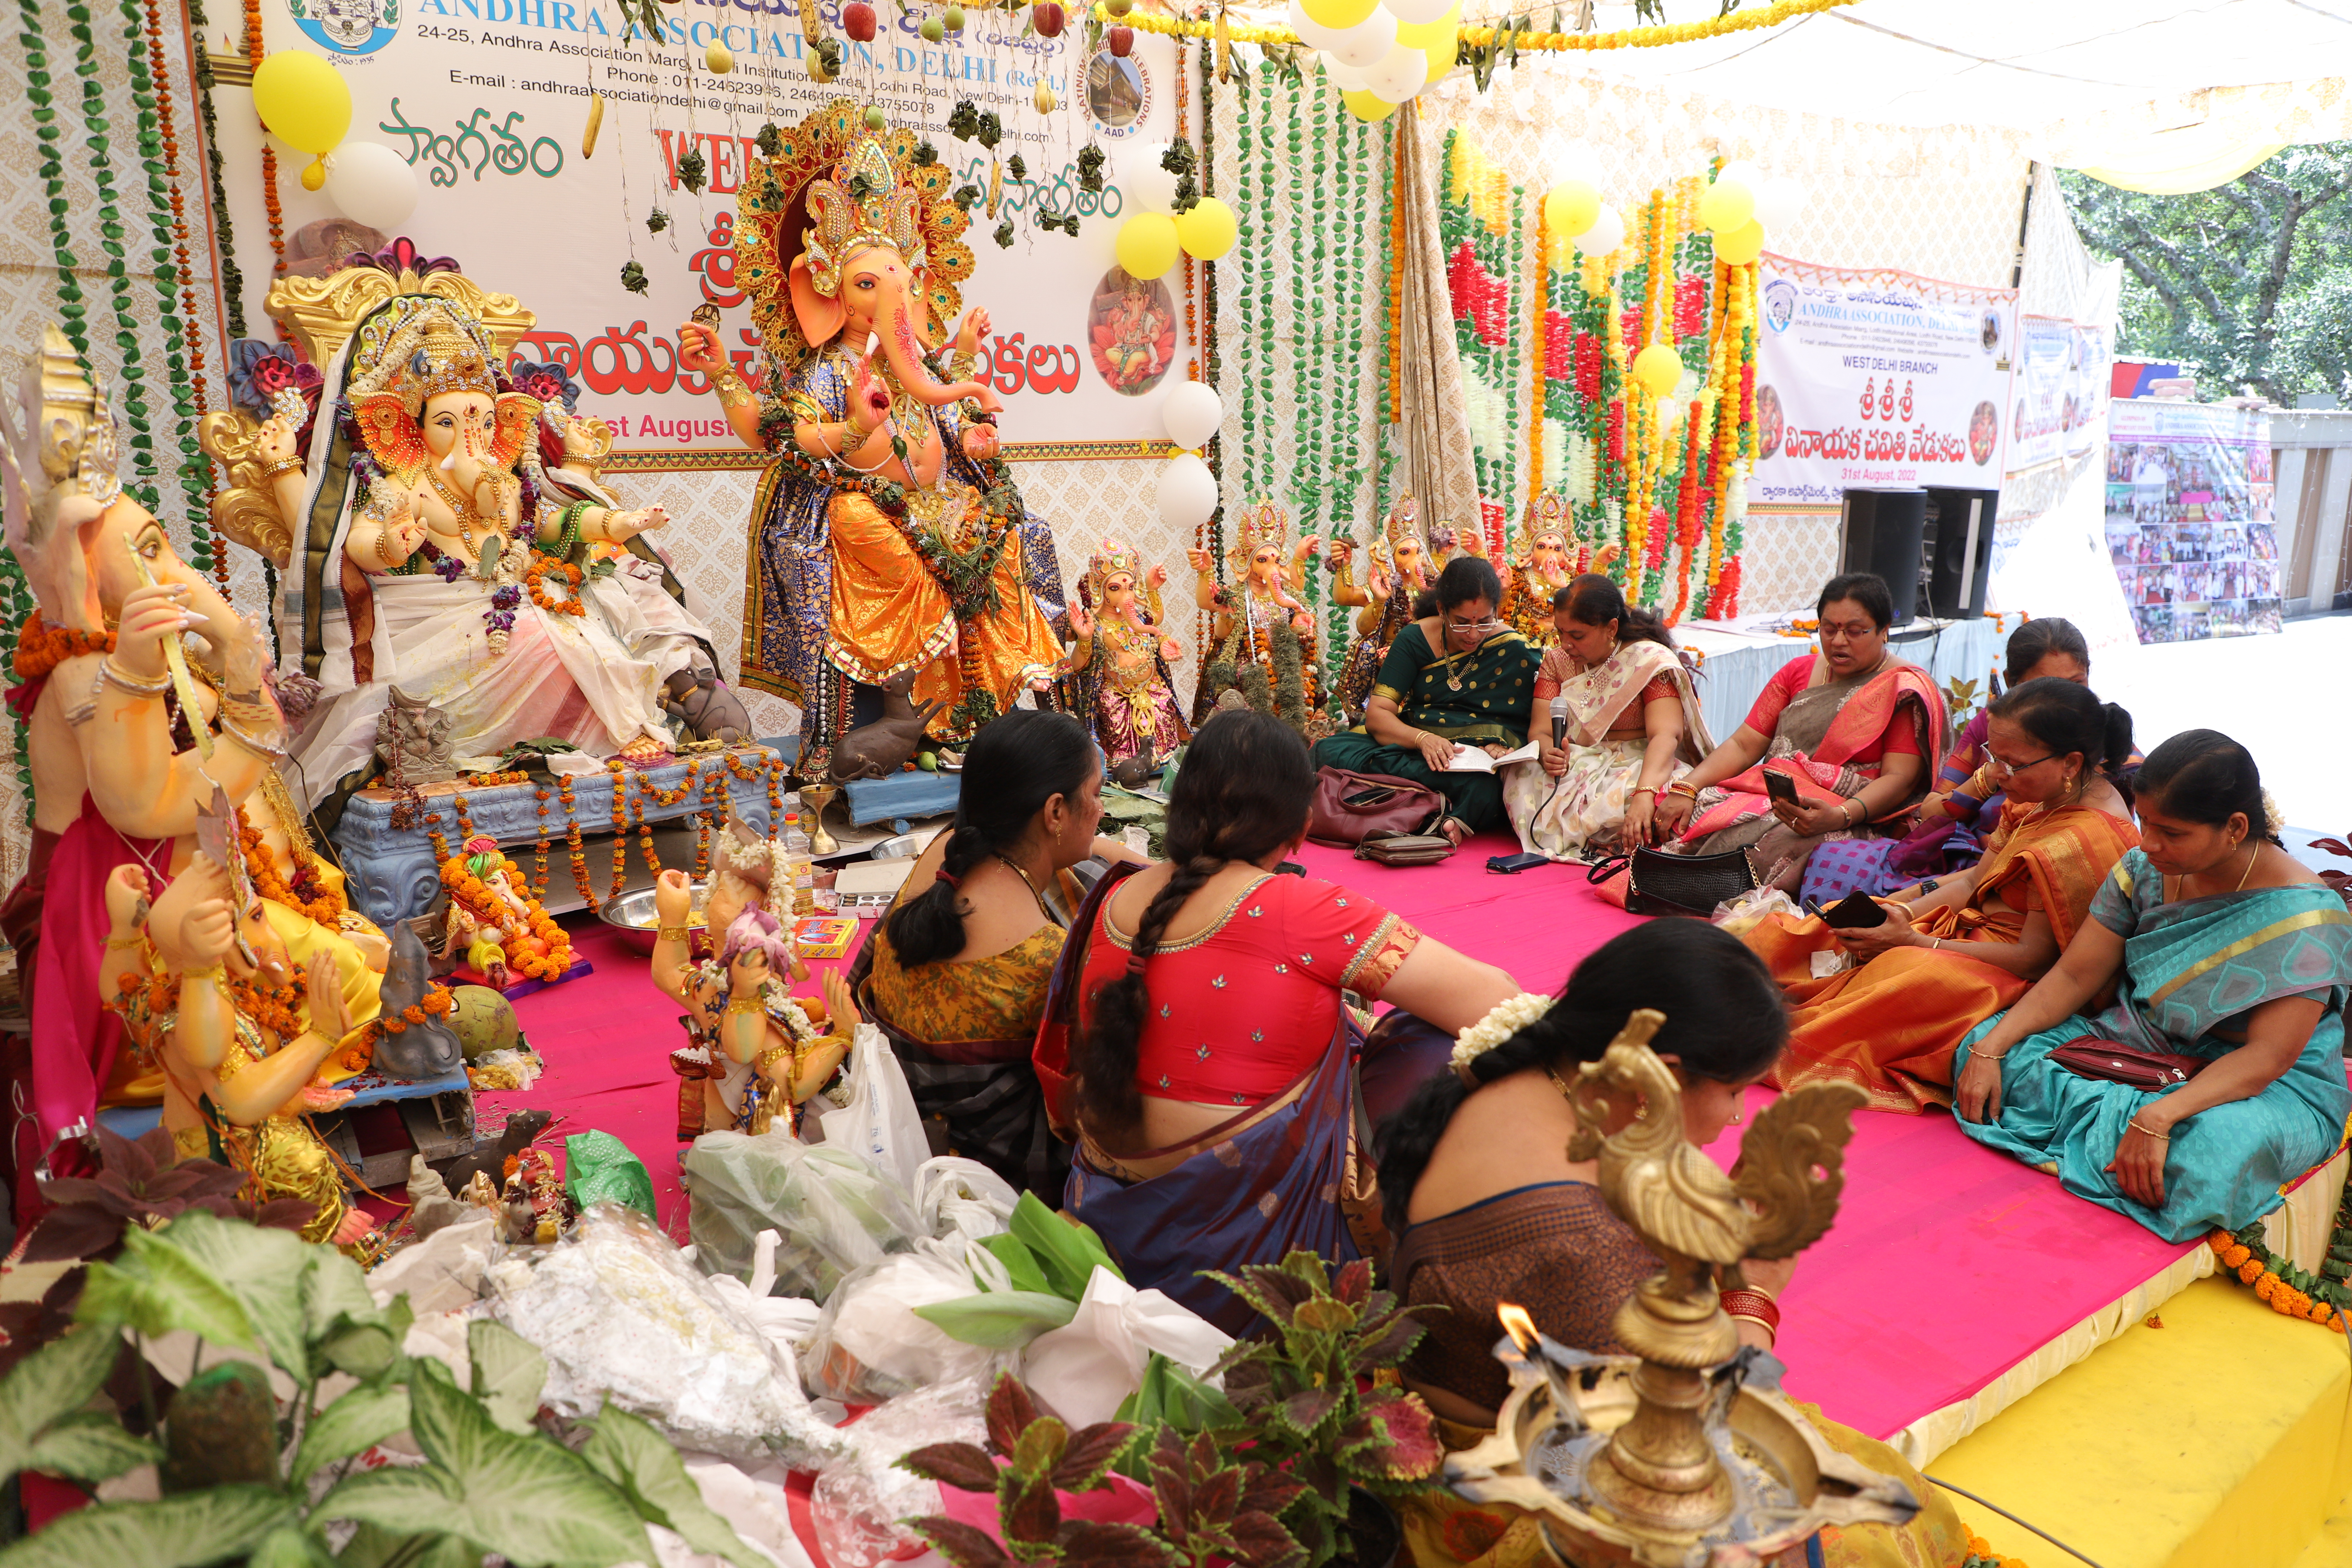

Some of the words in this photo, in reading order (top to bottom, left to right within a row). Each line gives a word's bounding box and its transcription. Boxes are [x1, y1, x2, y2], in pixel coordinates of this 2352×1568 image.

[359, 55, 374, 65] 1935
[417, 24, 475, 45] 24-25,
[481, 32, 543, 51] Andhra
[549, 40, 643, 63] Association
[830, 75, 867, 89] Area,
[913, 83, 951, 100] Road,
[956, 88, 983, 101] New
[616, 14, 884, 75] ASSOCIATON,
[893, 44, 997, 84] DELHI
[1006, 69, 1066, 95] (Red.)
[450, 69, 505, 88] E-mail
[607, 67, 658, 84] Phone
[1130, 50, 1152, 127] ELEBRATIONS
[378, 97, 564, 188] స్వాగతం
[1104, 127, 1124, 138] AAD
[1798, 303, 1847, 320] ANDHRA
[1842, 355, 1871, 369] WEST
[1872, 357, 1898, 372] DELHI
[1900, 359, 1939, 375] BRANCH
[1859, 377, 1874, 420] శ్రీ
[1878, 378, 1894, 422] శ్రీ
[1899, 379, 1914, 423] శ్రీ
[1785, 425, 1862, 461] వినాయక
[1864, 428, 1906, 462] చవితి
[1909, 423, 1966, 463] వేడుకలు
[1841, 468, 1860, 480] 31st
[1862, 469, 1895, 483] August,
[1897, 469, 1917, 482] 2022
